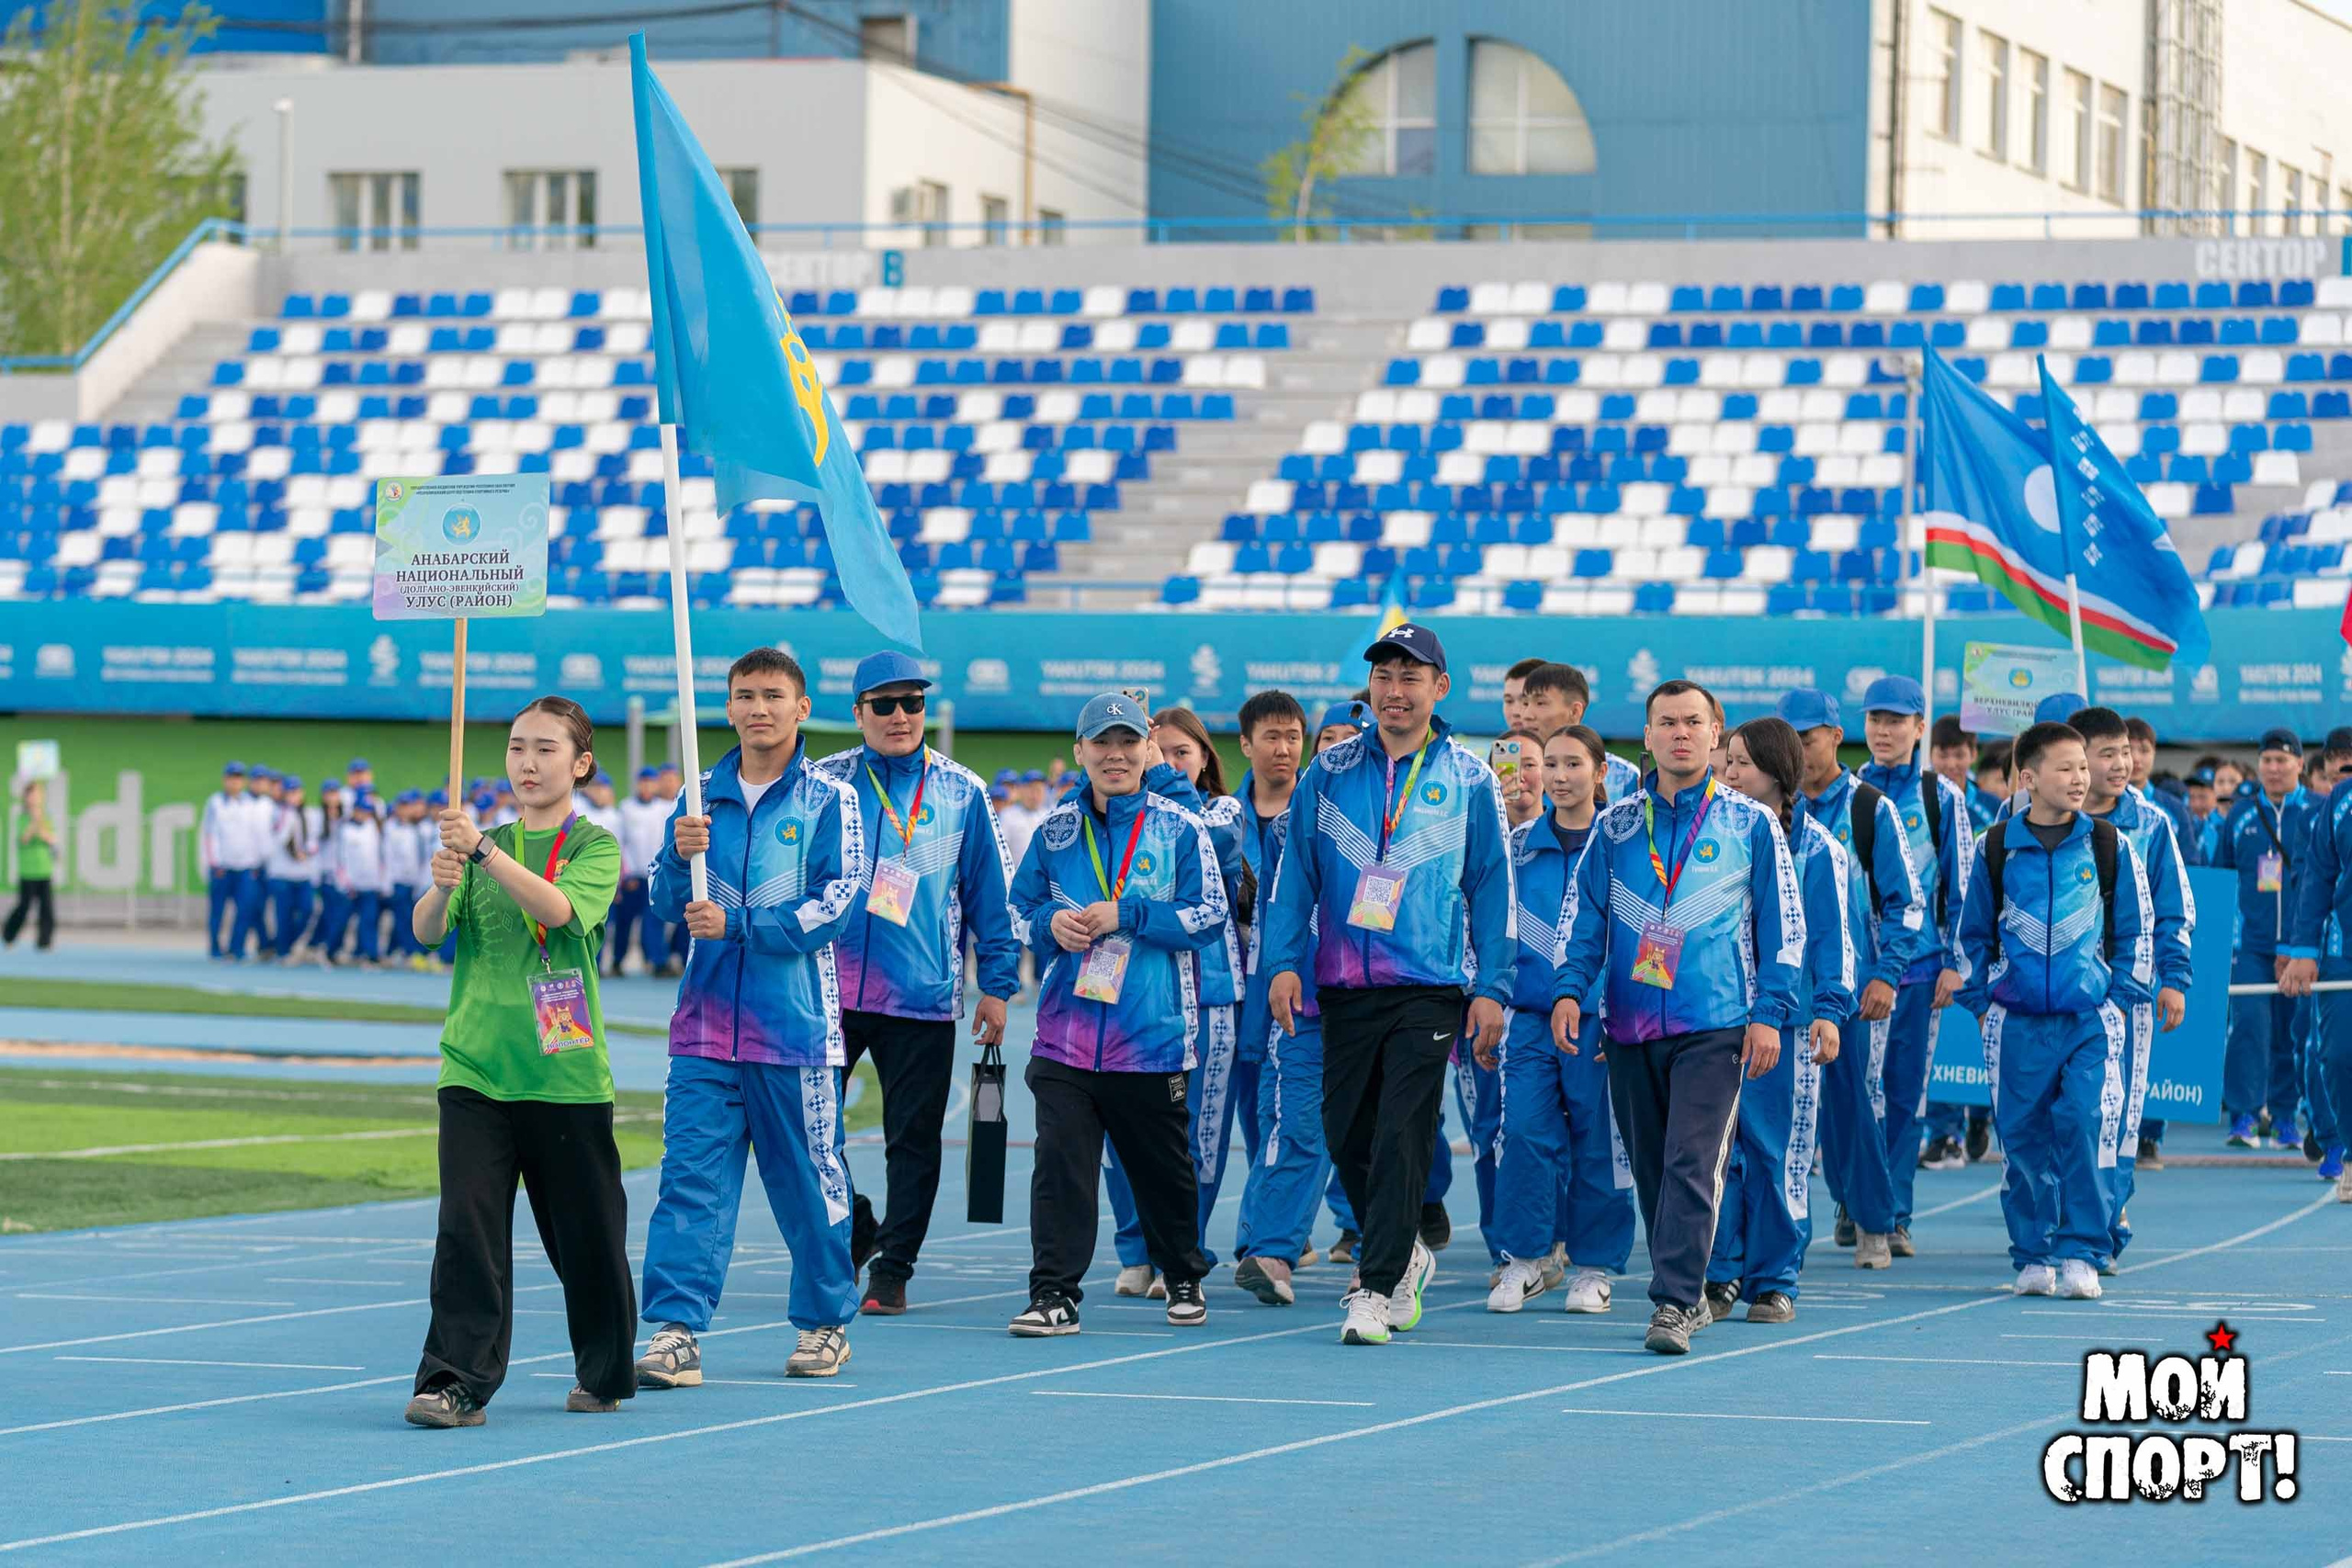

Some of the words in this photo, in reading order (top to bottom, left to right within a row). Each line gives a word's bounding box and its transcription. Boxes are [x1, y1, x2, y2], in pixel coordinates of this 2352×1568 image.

[2195, 239, 2327, 276] СЕКТОР
[412, 548, 510, 566] АНАБАРСКИЙ
[396, 566, 525, 583] НАЦИОНАЛЬНЫЙ
[400, 582, 519, 594] (ДОЛГАНО-ЭВЕНКИЙСКИЙ)
[406, 596, 447, 608] УЛУС
[449, 592, 514, 608] (РАЙОН)
[2012, 707, 2035, 717] (РАЙ
[1933, 1064, 1988, 1085] ХНЕВИ
